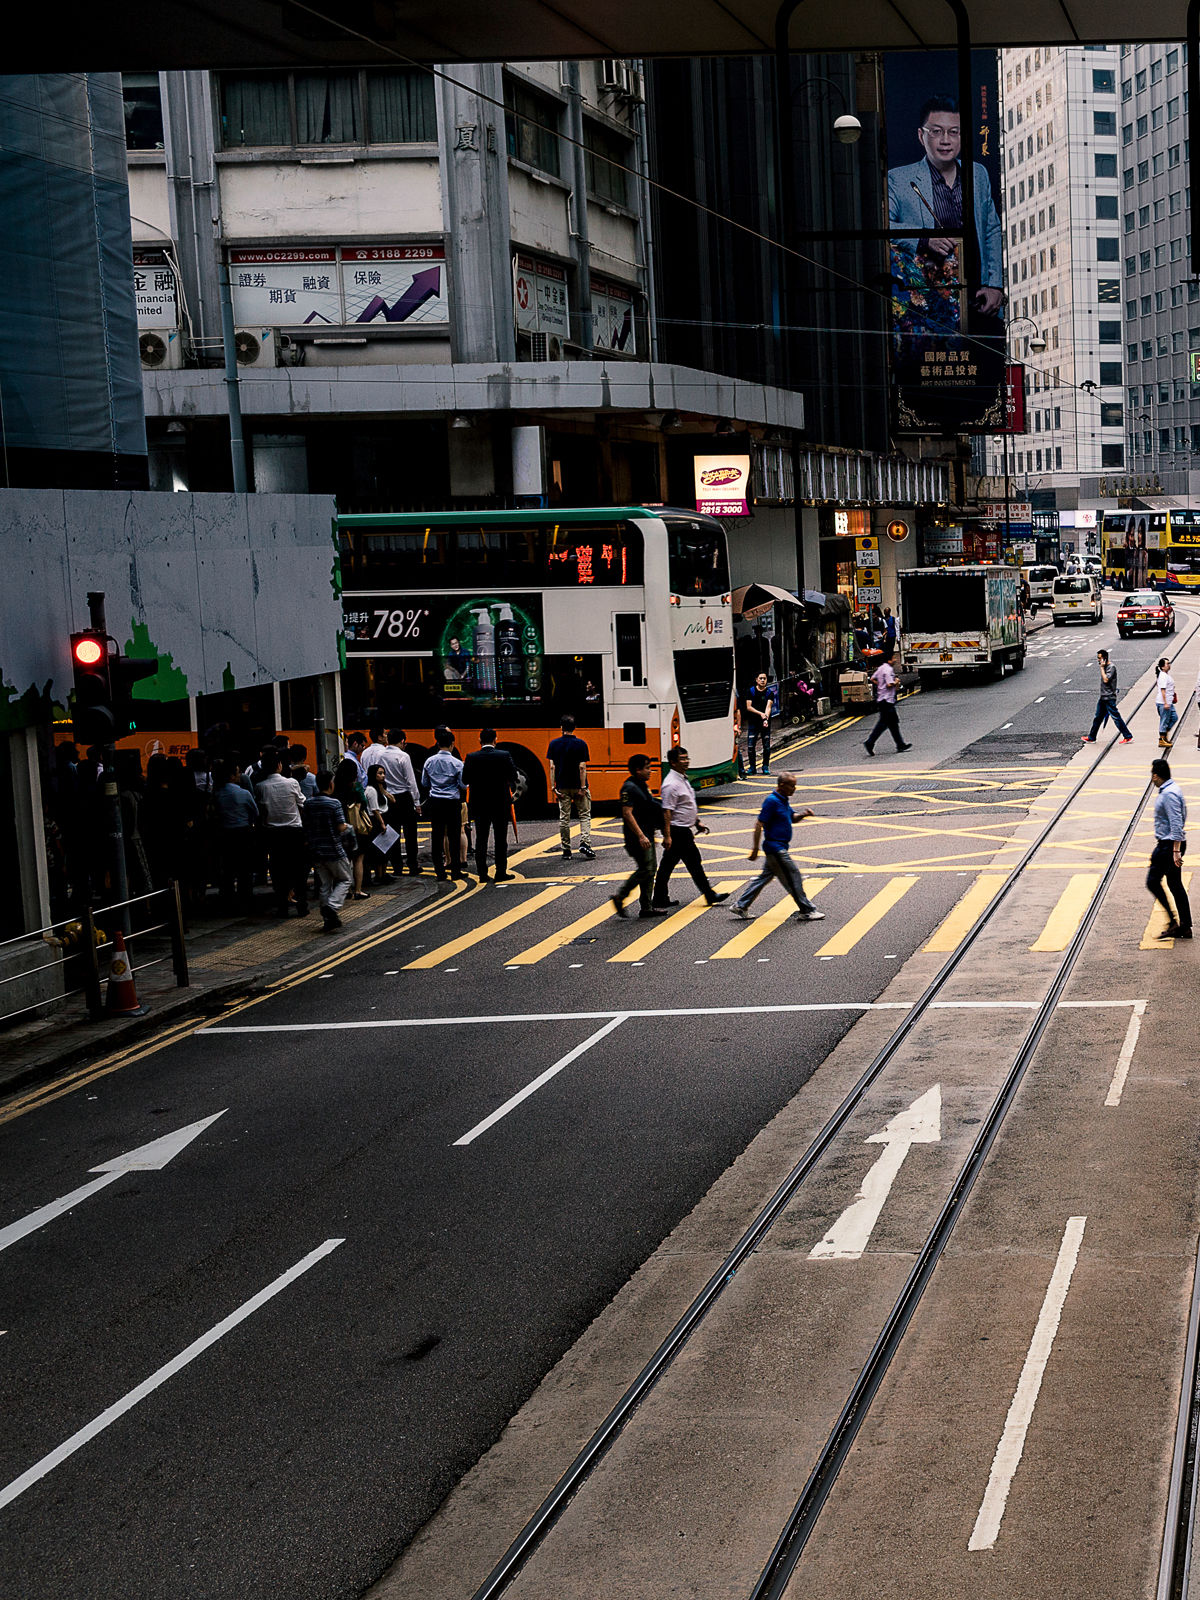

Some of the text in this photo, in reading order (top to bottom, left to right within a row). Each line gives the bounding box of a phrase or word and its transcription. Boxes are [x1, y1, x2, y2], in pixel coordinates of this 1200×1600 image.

[238, 251, 329, 261] www.OC2299.com
[372, 248, 433, 259] 3188 2299
[134, 271, 174, 291] 金融
[238, 273, 267, 288] 證券
[302, 276, 331, 290] 融資
[354, 270, 382, 285] 保險
[269, 289, 297, 304] 期貨
[136, 306, 163, 315] mited
[700, 505, 742, 514] 2815 3000
